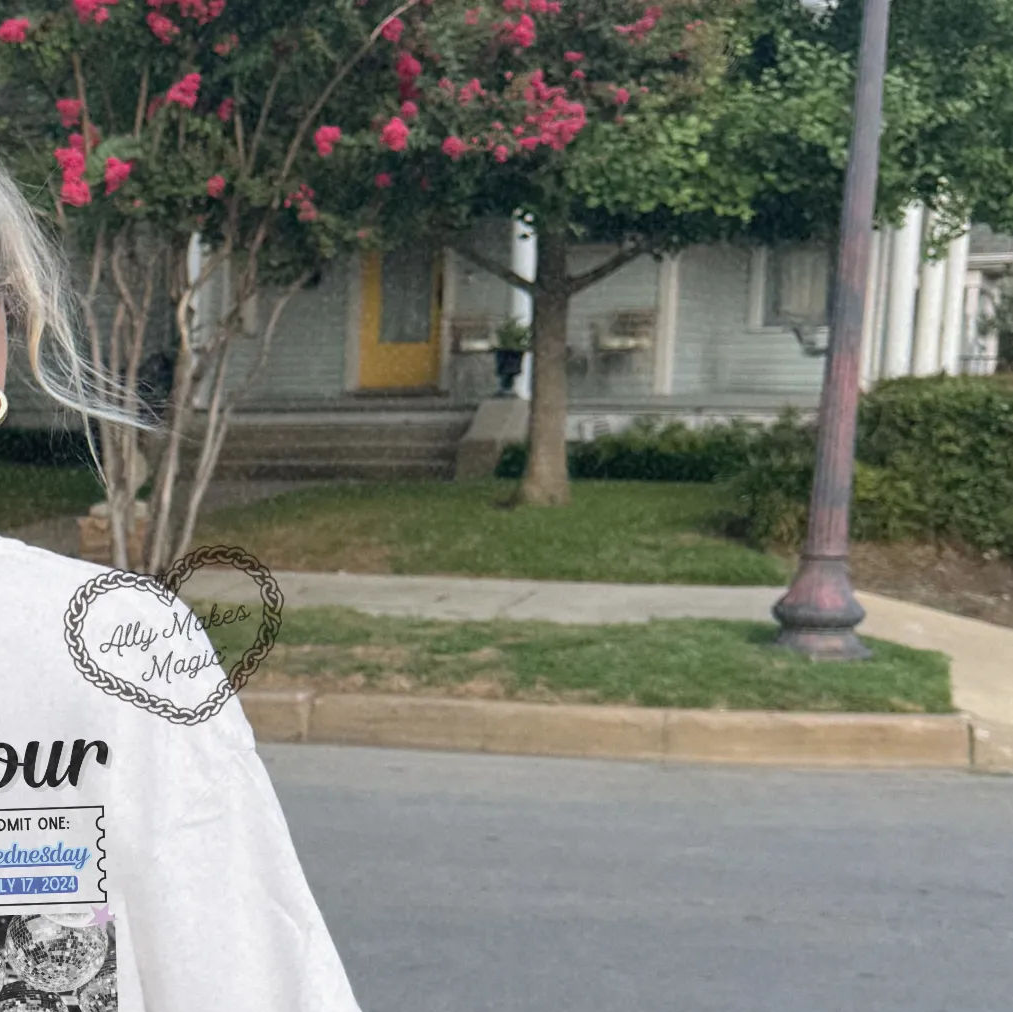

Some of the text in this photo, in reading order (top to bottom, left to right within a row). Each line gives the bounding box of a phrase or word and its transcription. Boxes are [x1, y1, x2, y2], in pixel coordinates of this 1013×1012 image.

[38, 817, 70, 830] ONE:
[21, 878, 38, 894] 17,
[42, 876, 76, 892] 2024
